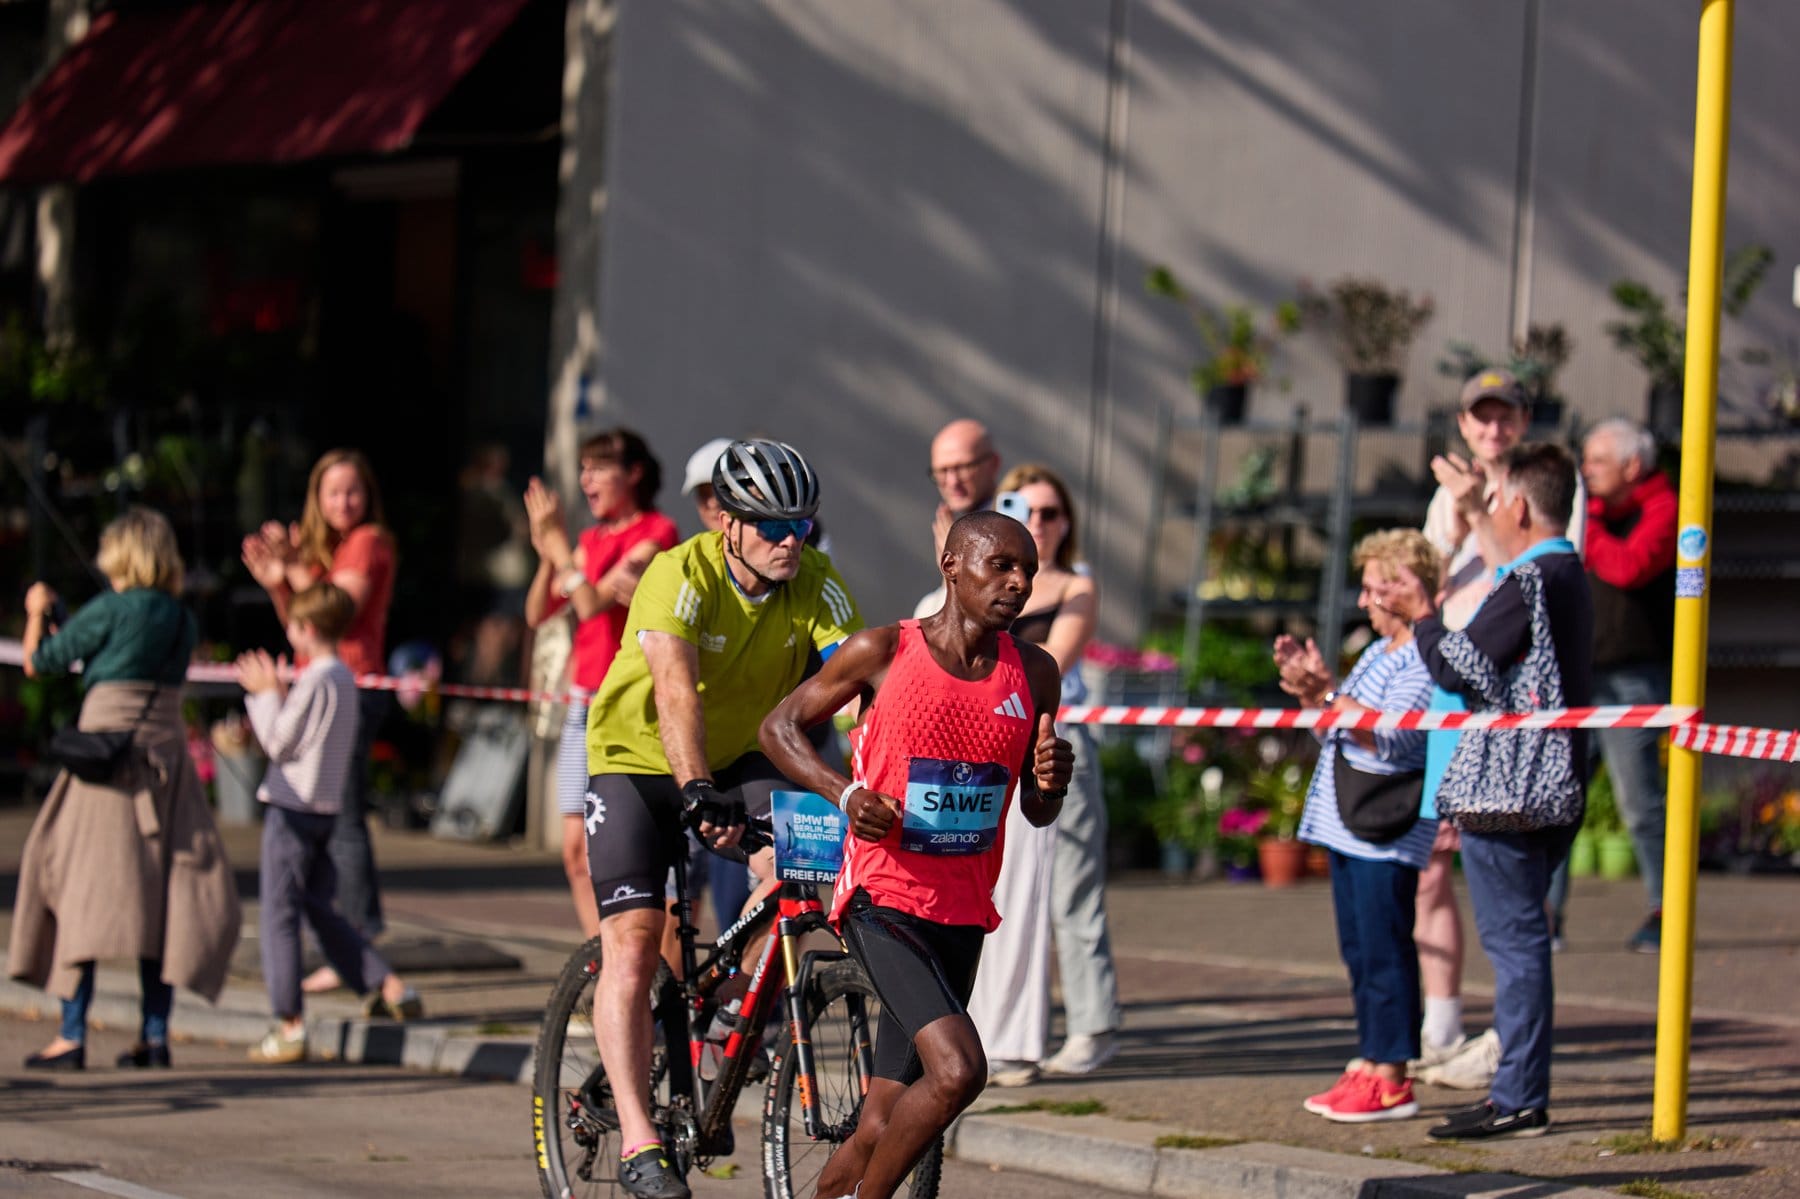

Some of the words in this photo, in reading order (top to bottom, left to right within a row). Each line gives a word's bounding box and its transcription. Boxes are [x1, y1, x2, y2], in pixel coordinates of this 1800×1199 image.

[923, 791, 992, 813] SAWE
[793, 813, 822, 826] BMW
[794, 825, 823, 833] BERLIN
[794, 832, 840, 842] MARATHON
[930, 832, 980, 844] zalando
[783, 868, 815, 881] FREIE
[534, 1096, 549, 1169] MAXXIS
[775, 1125, 784, 1142] DT
[776, 1144, 785, 1171] SWISS
